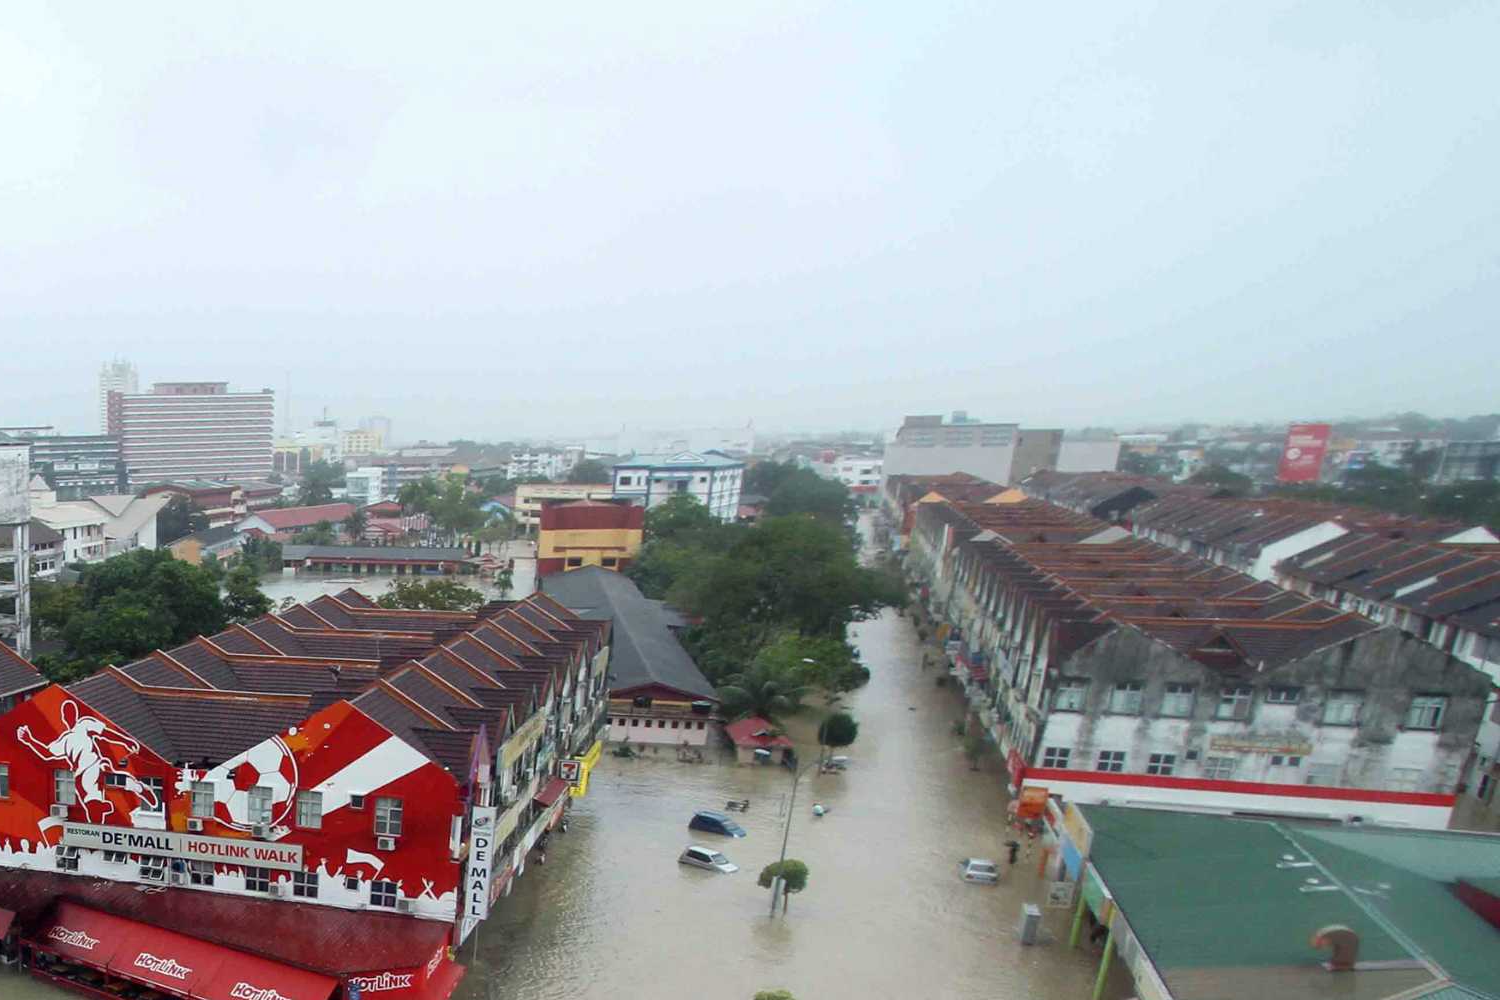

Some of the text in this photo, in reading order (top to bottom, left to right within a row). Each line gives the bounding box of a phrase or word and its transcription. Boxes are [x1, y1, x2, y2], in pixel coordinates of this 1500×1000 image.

[66, 828, 298, 864] RESTORAN DE'MALL HOTLINK WALK
[475, 837, 489, 862] DE
[471, 867, 487, 916] MALL
